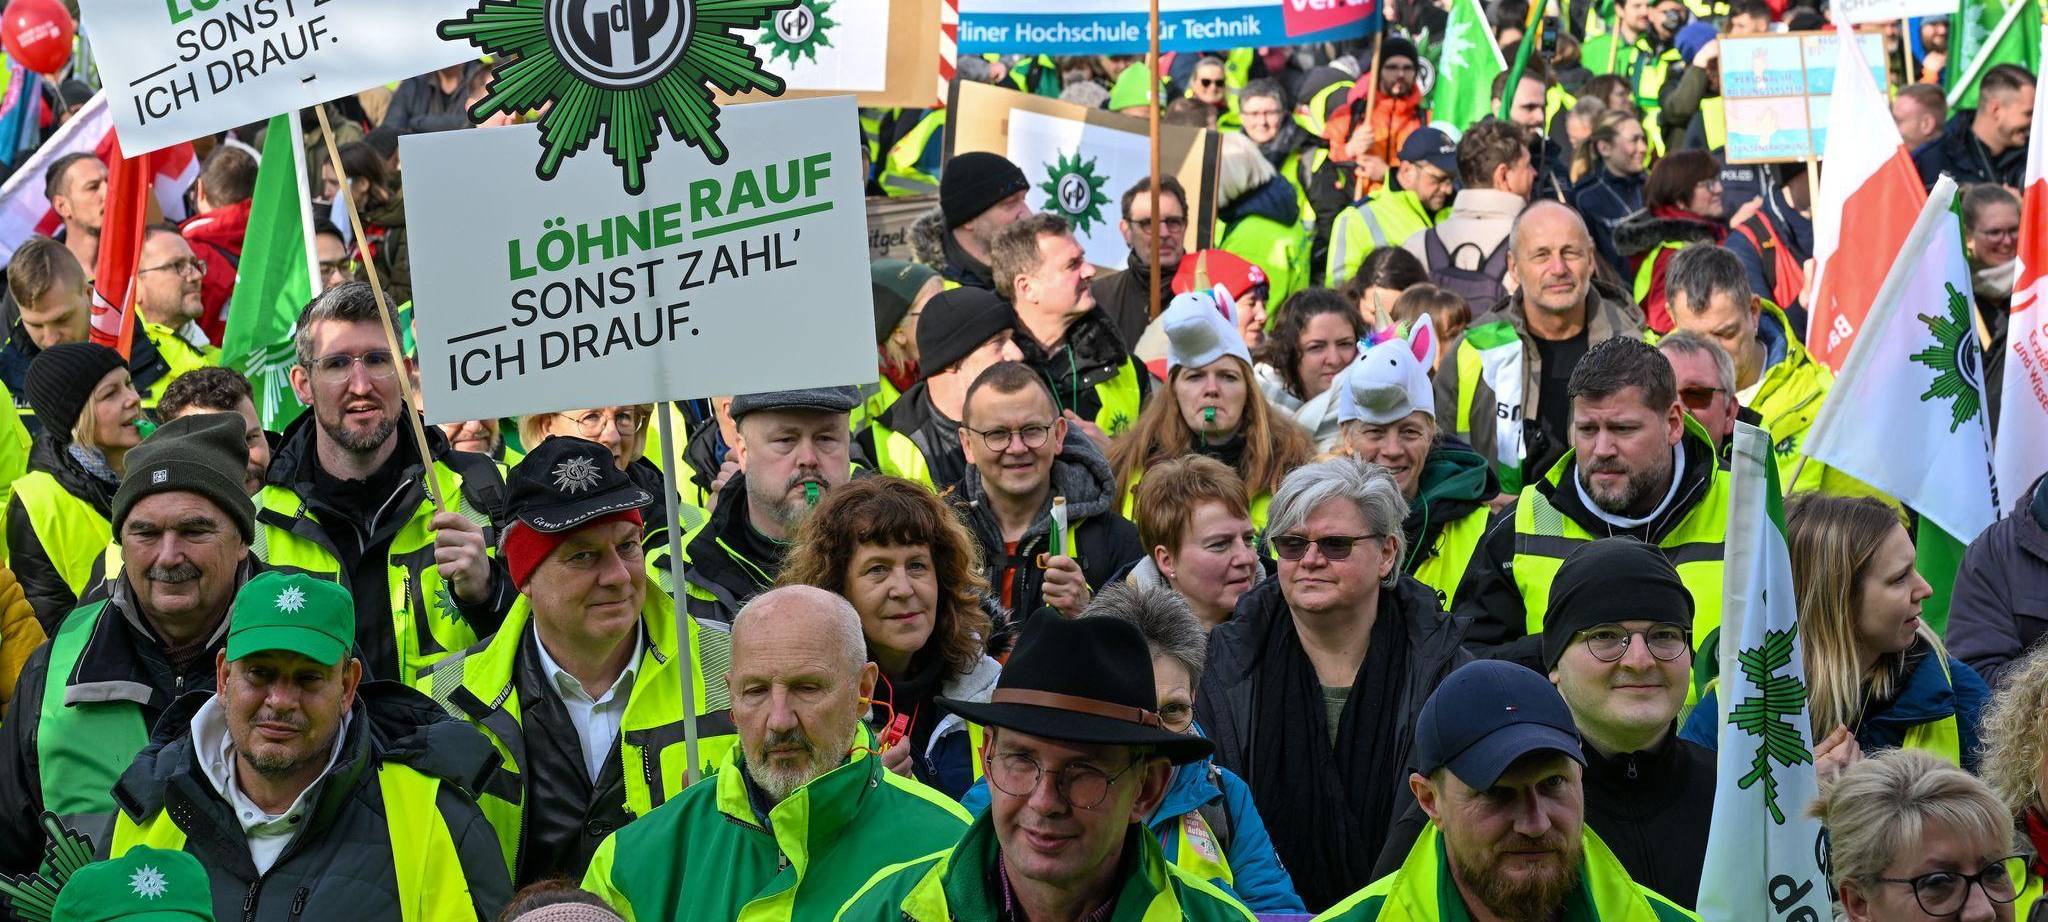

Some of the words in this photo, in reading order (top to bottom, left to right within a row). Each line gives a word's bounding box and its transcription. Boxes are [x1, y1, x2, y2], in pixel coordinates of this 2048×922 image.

[958, 21, 1009, 42] liner
[1015, 21, 1139, 42] Hochschule
[1182, 14, 1261, 39] Technik
[134, 72, 200, 126] ICH
[206, 15, 338, 95] DRAUF.
[689, 152, 832, 223] RAUF
[508, 203, 683, 281] LÖHNE
[511, 258, 664, 327] SONST
[449, 339, 526, 391] ICH
[540, 301, 699, 370] DRAUF.
